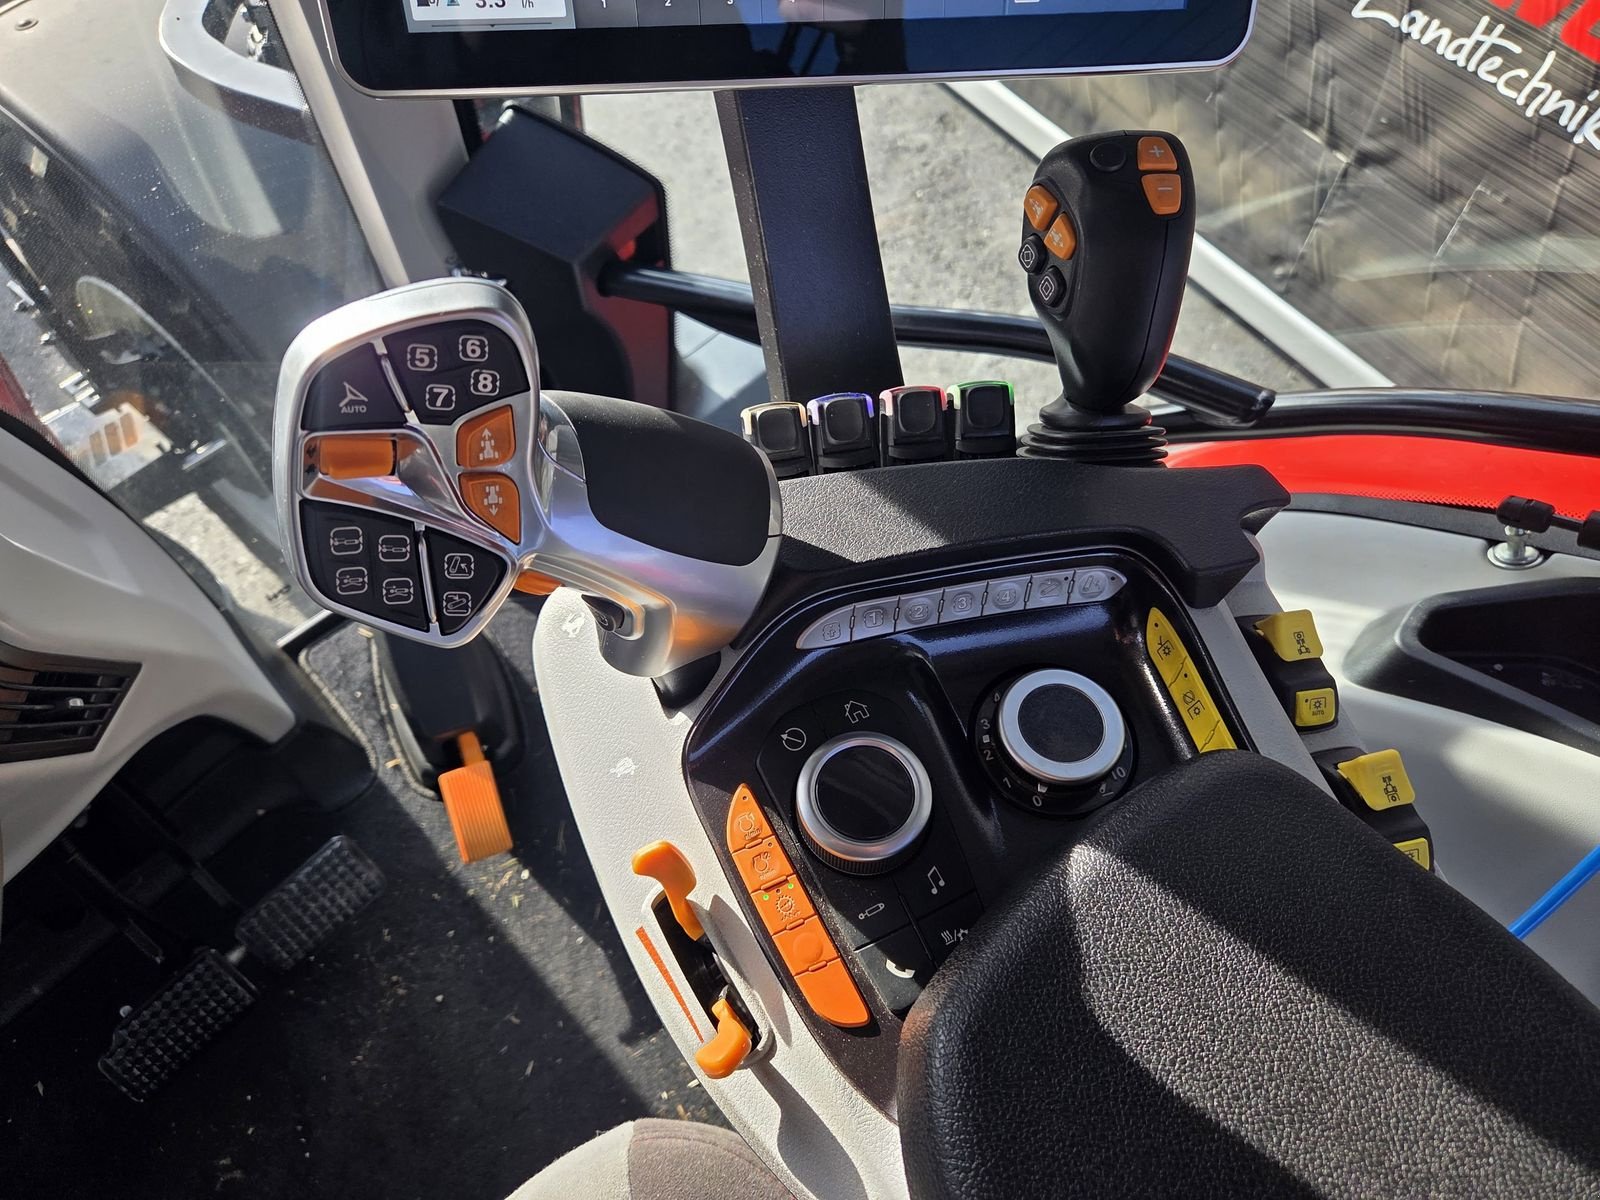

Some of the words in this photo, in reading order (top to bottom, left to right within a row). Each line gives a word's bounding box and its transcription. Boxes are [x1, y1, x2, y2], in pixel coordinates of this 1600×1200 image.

[415, 348, 430, 367] 5
[466, 339, 481, 358] 6
[433, 388, 449, 407] 7
[477, 373, 493, 392] 8
[340, 405, 367, 414] AUTO
[980, 718, 990, 730] 3
[984, 750, 994, 761] 2
[1111, 766, 1126, 780] 10
[1003, 777, 1012, 788] 1
[1032, 795, 1042, 807] 0
